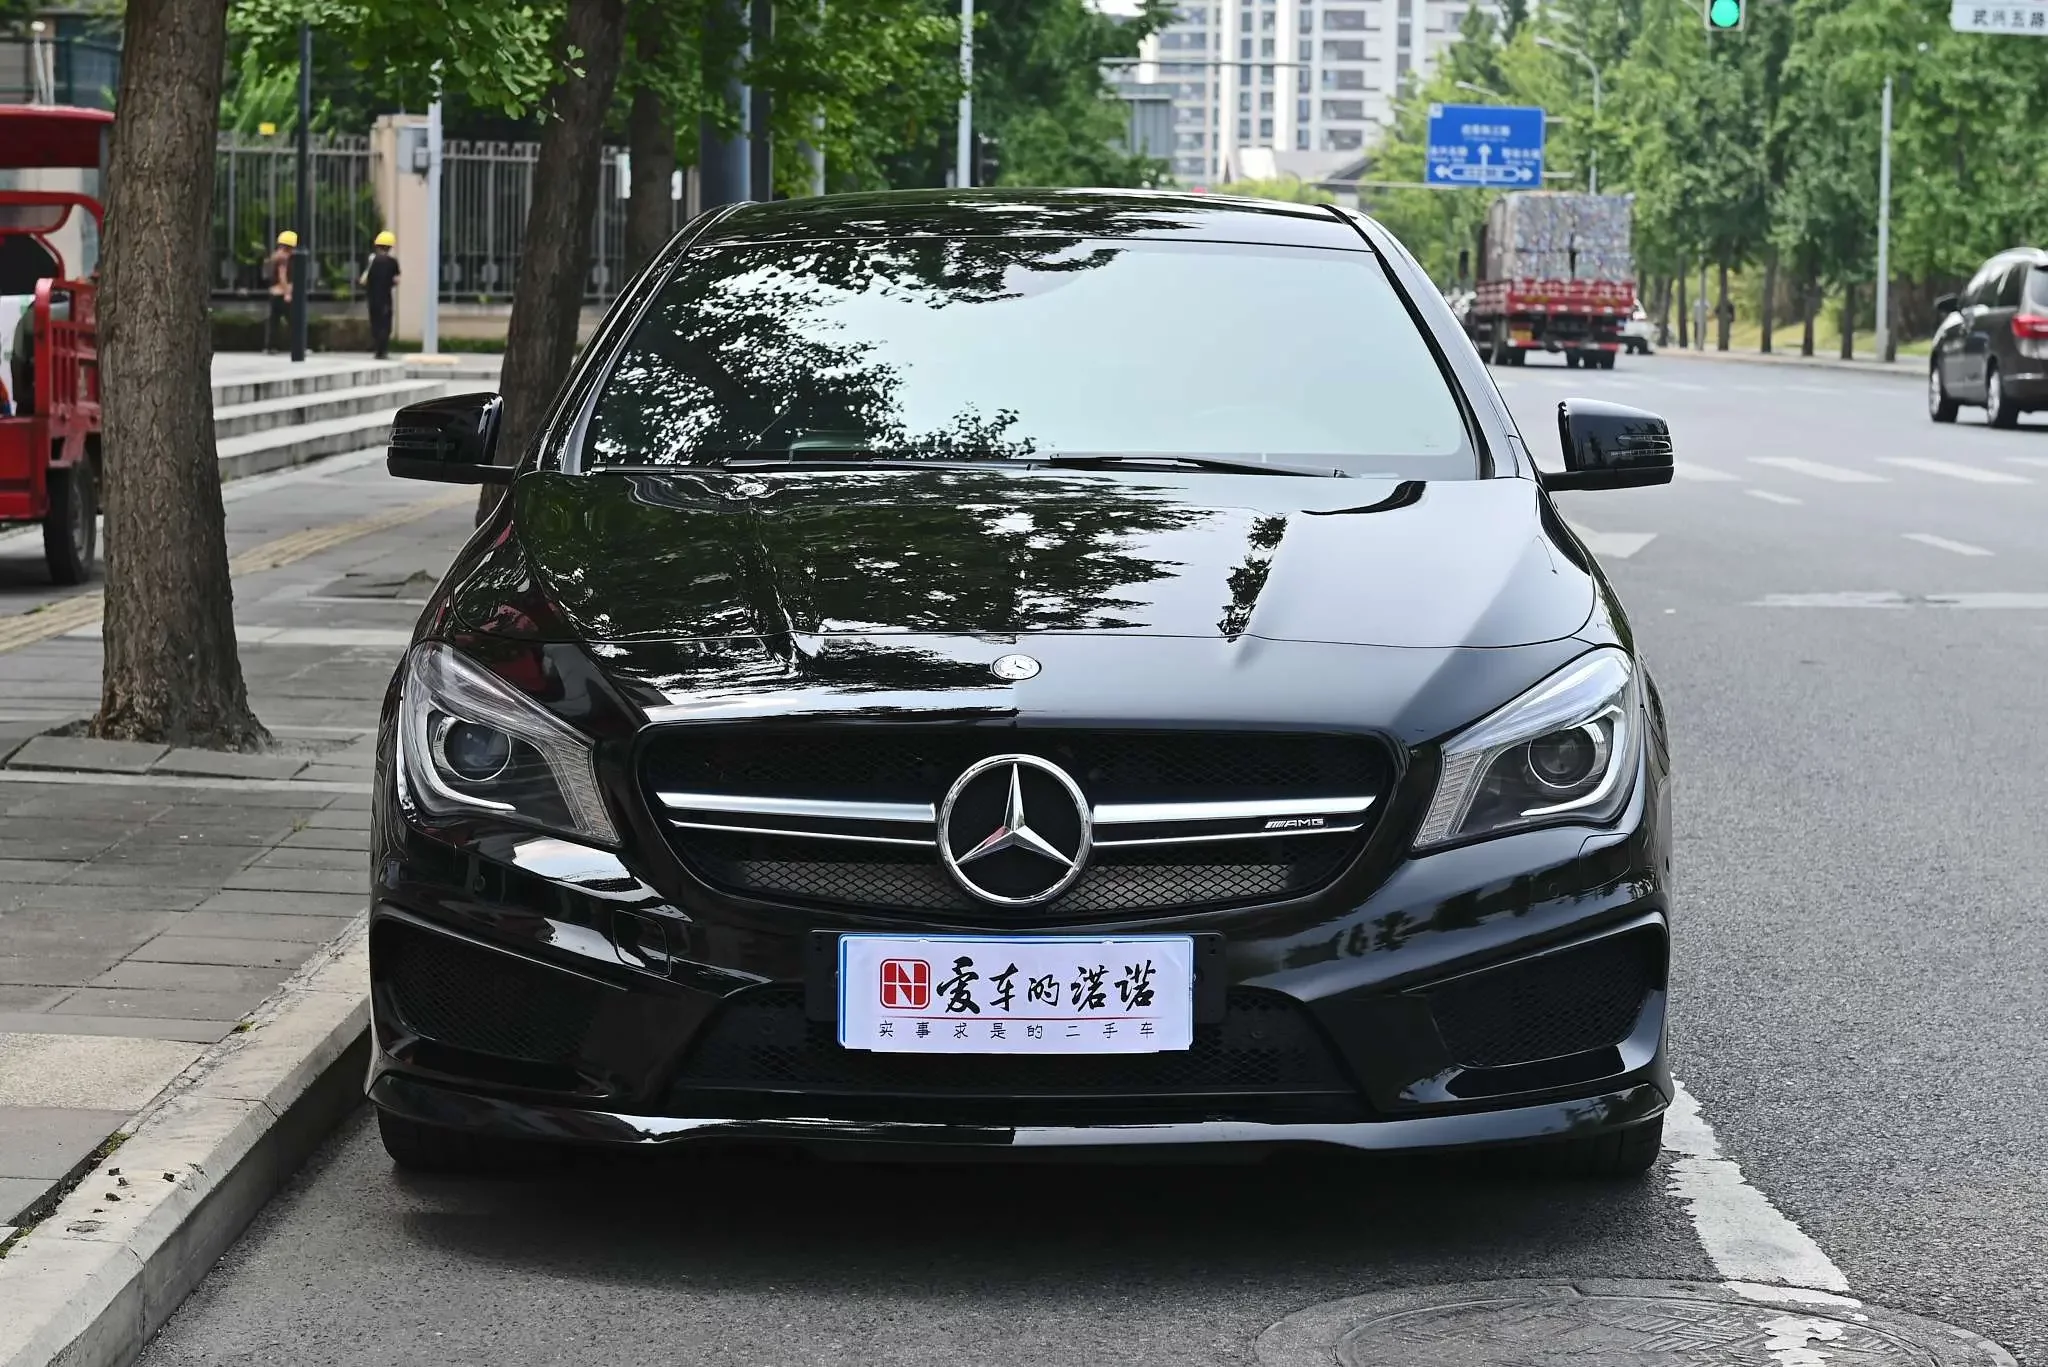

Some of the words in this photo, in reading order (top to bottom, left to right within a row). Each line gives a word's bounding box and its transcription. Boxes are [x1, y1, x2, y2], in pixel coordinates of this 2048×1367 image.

[1283, 818, 1324, 828] AMG
[879, 1020, 1155, 1039] 实事求是的二手车
